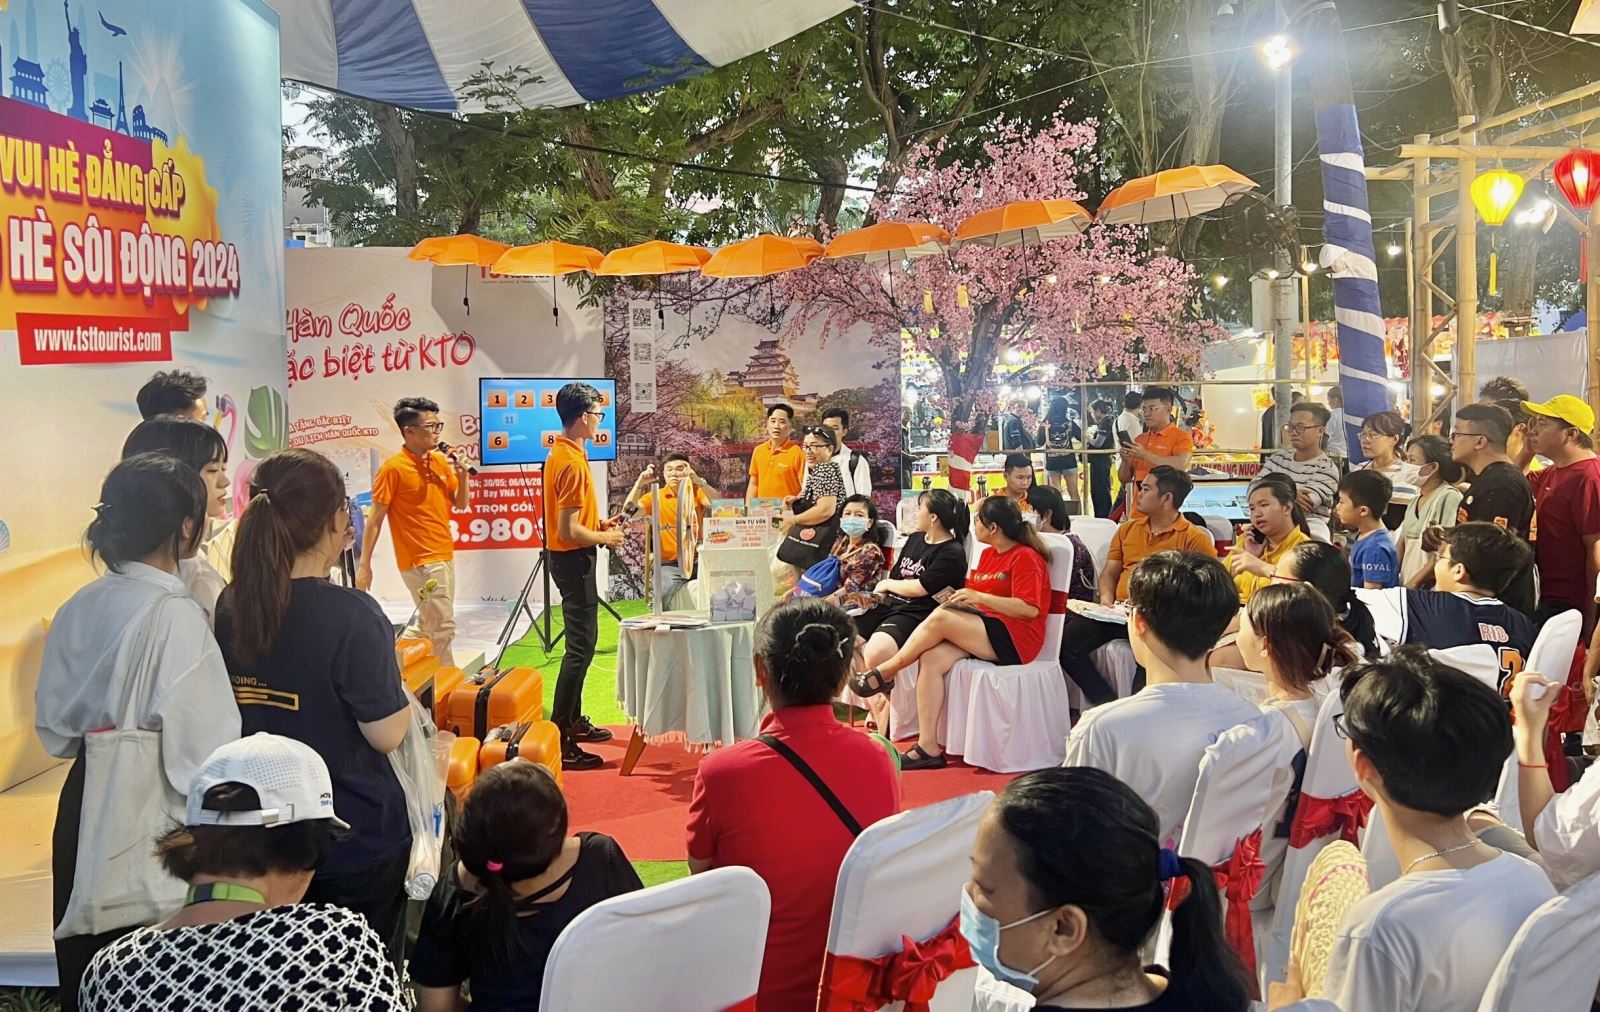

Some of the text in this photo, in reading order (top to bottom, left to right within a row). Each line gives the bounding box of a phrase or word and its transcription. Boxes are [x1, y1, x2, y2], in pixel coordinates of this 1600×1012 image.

[0, 135, 185, 214] VUI HÈ ĐẲNG CẤP
[9, 206, 240, 298] HÈ SÔI ĐỘNG 2024
[339, 293, 411, 337] Quốc
[34, 326, 162, 352] www.tsttourist.com
[287, 329, 476, 388] ặc biệt từ KTO
[494, 394, 500, 404] 1
[521, 394, 527, 405] 2
[547, 393, 553, 404] 3
[505, 416, 513, 424] 11
[363, 427, 379, 437] KTO
[494, 433, 608, 446] 6 8 10
[475, 504, 508, 515] TRỌN
